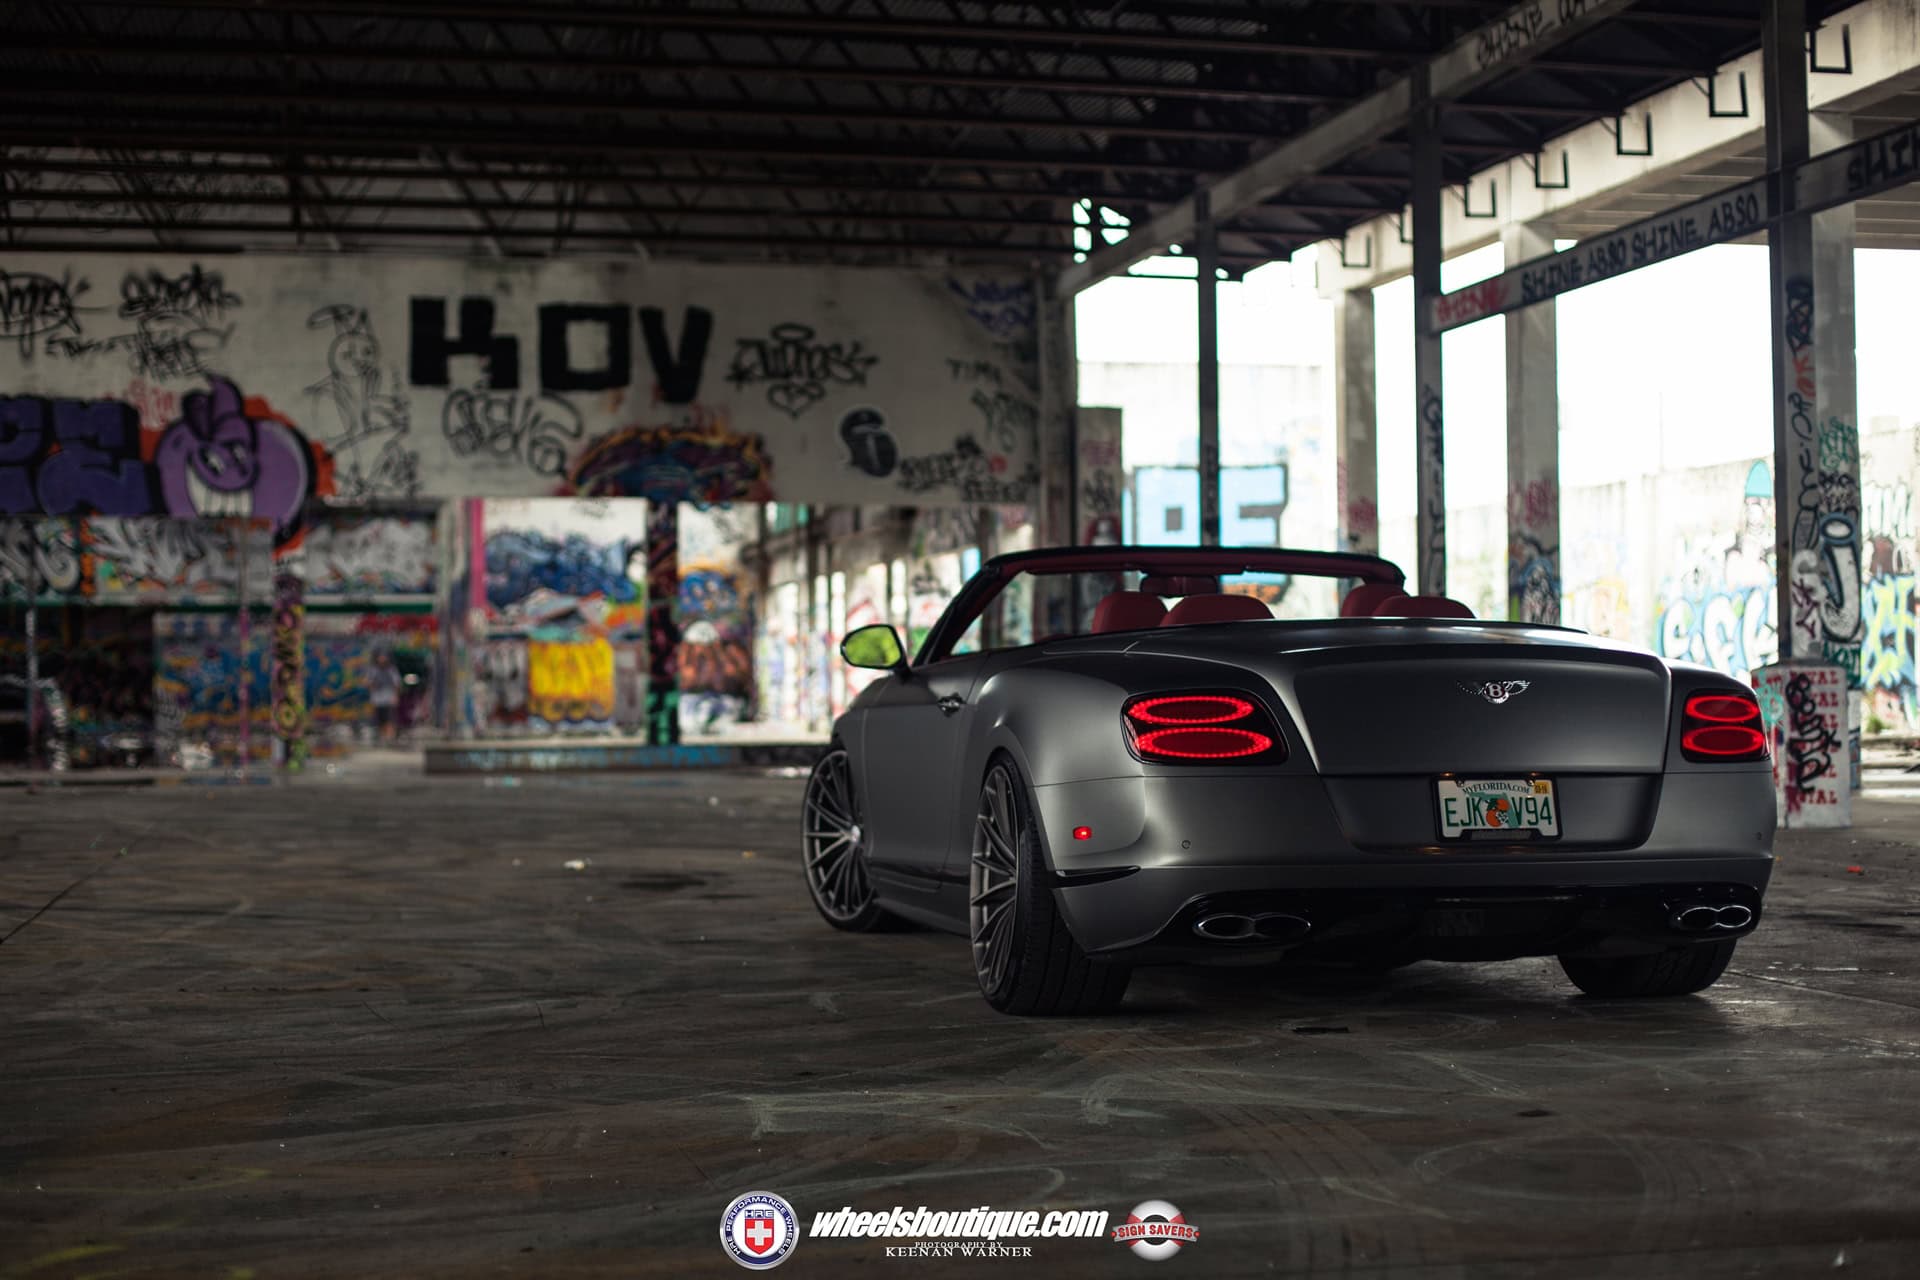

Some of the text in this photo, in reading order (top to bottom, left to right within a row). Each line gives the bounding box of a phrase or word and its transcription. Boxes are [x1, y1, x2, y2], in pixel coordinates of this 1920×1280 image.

[1521, 257, 1583, 300] SHINE
[1586, 239, 1627, 276] ABSO
[1631, 219, 1700, 265] SHINE
[1708, 191, 1760, 239] ABSO
[1462, 782, 1530, 795] MYFLORIDA.COM
[1444, 797, 1553, 828] EJK V94
